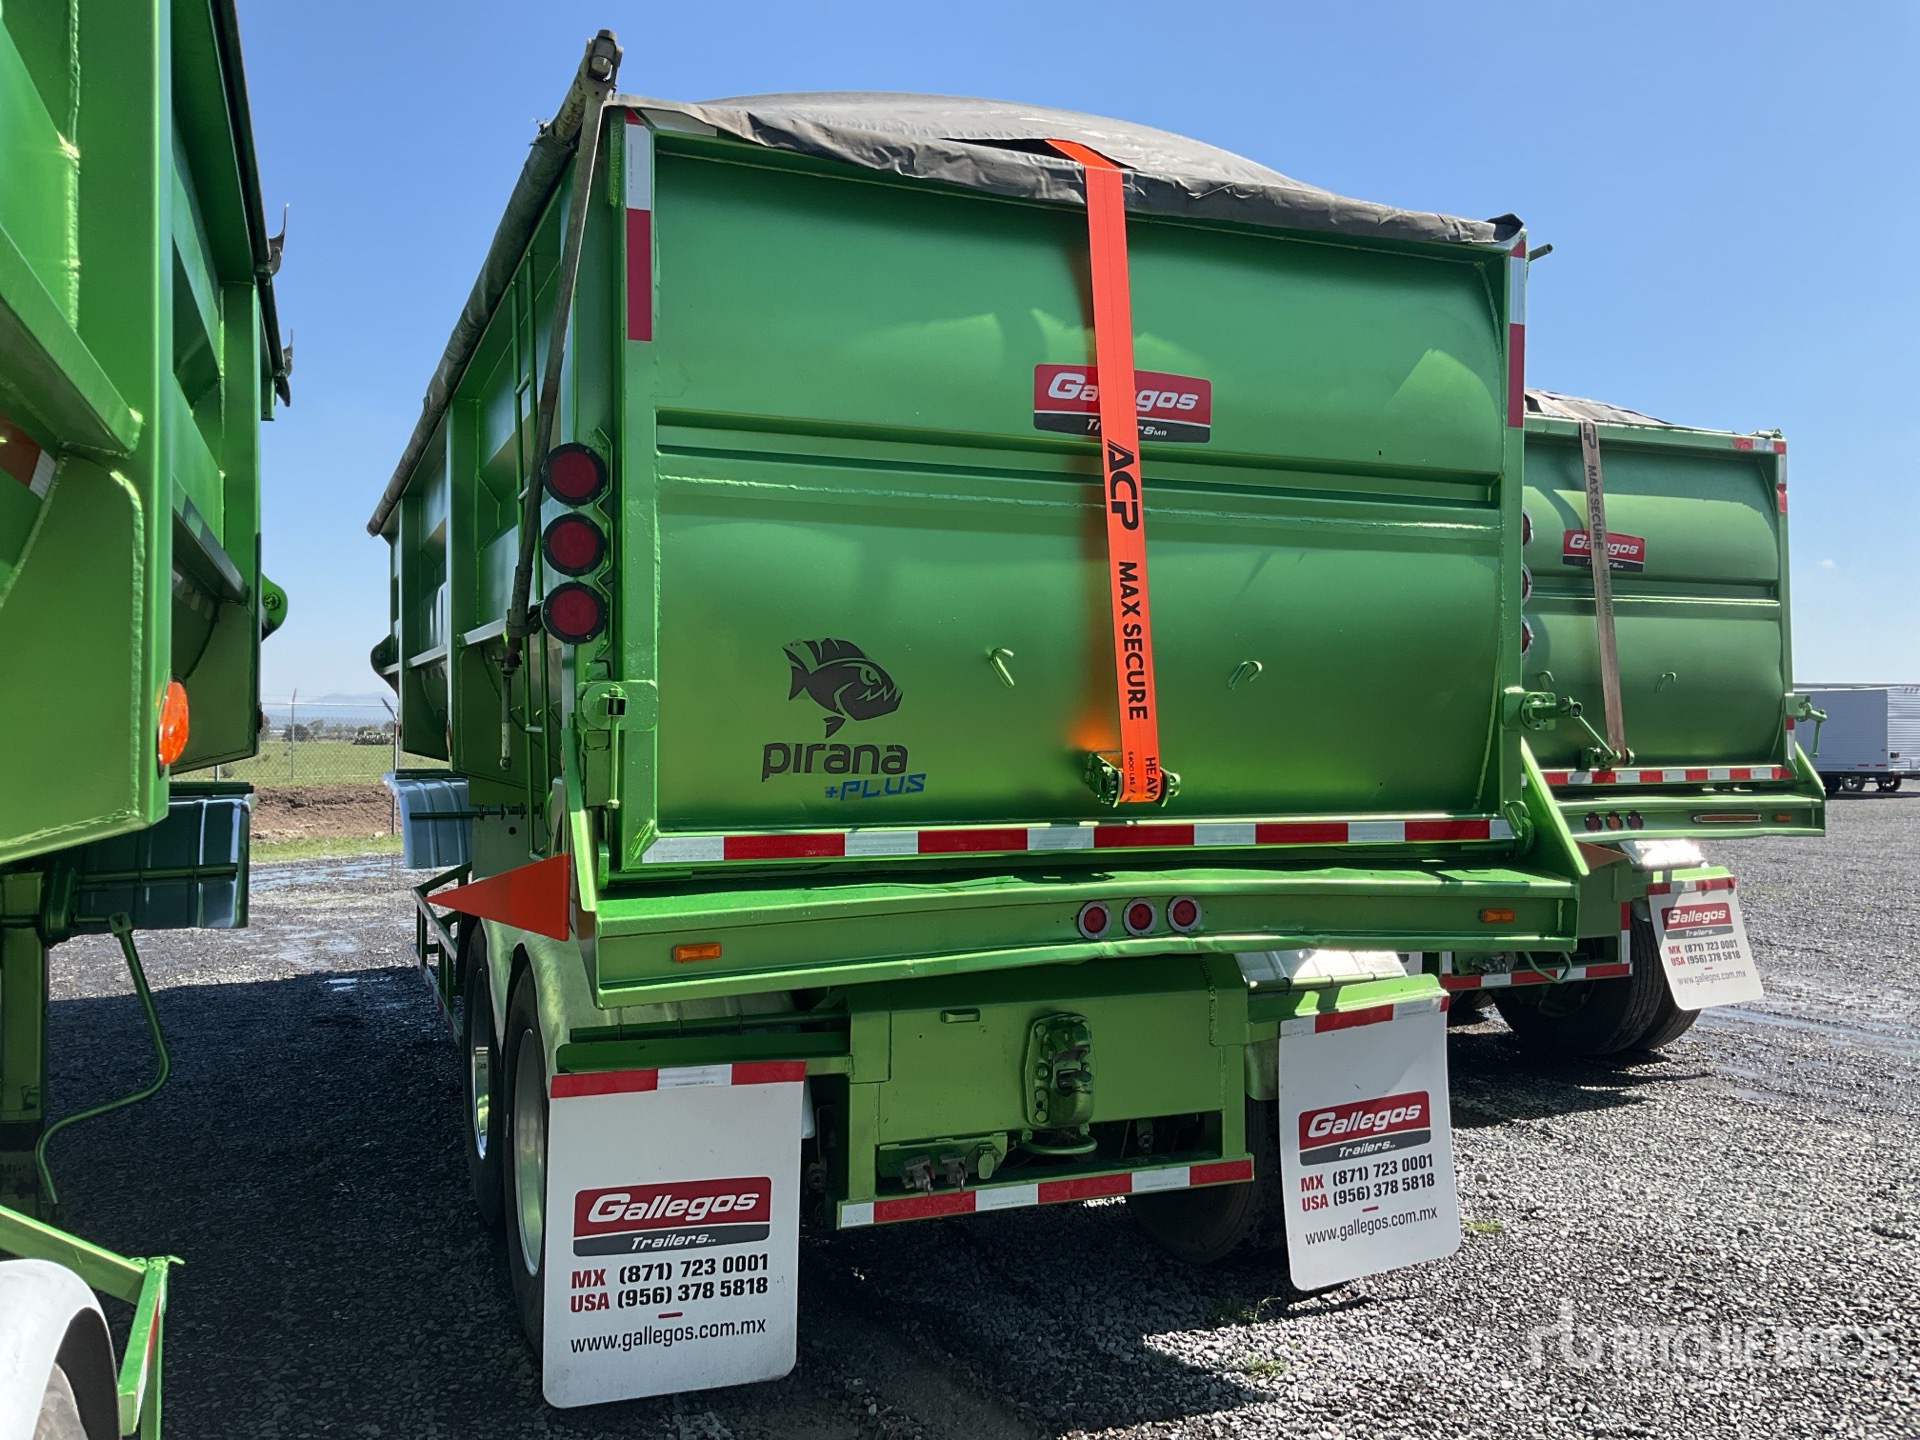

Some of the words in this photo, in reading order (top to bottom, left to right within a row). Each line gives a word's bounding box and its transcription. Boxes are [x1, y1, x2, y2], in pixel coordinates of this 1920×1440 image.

[1048, 372, 1199, 412] Gagos
[1583, 422, 1596, 449] CP
[1107, 439, 1139, 531] ACP
[1588, 465, 1599, 495] MAX
[1590, 499, 1604, 551] SECURE
[1569, 533, 1639, 555] Gagos
[1119, 561, 1141, 617] MAX
[1122, 623, 1149, 721] SECURE
[761, 742, 909, 783] pirana
[1145, 756, 1159, 800] HEAVY
[1668, 909, 1727, 924] Gallegos
[1668, 945, 1681, 954] MX
[1684, 942, 1704, 954] (871)
[1706, 941, 1719, 951] 723
[1720, 939, 1738, 949] 0001
[1670, 956, 1686, 966] USA
[1687, 954, 1707, 965] (956)
[1708, 952, 1722, 962] 378
[1722, 950, 1741, 960] 5818
[1307, 1104, 1422, 1138] Gallegos
[1339, 1140, 1391, 1158] Trailers
[1300, 1174, 1324, 1192] MX
[1332, 1166, 1369, 1187] (871)
[1373, 1160, 1398, 1178] 723
[1402, 1153, 1433, 1172] 0001
[588, 1192, 760, 1222] Gallegos
[1301, 1193, 1329, 1212] USA
[1333, 1185, 1370, 1206] (956)
[1373, 1179, 1399, 1198] 378
[1401, 1172, 1435, 1191] 5818
[631, 1233, 710, 1250] Trailers
[1305, 1206, 1438, 1245] www.gallegos.com.mx
[571, 1269, 606, 1289] MX
[619, 1262, 673, 1285] (871)
[680, 1258, 716, 1278] 723
[722, 1253, 768, 1274] 0001
[570, 1292, 610, 1313] USA
[617, 1285, 672, 1309] (956)
[677, 1282, 715, 1302] 378
[720, 1277, 769, 1297] 5818
[570, 1318, 766, 1353] www.gallegos.com.mx
